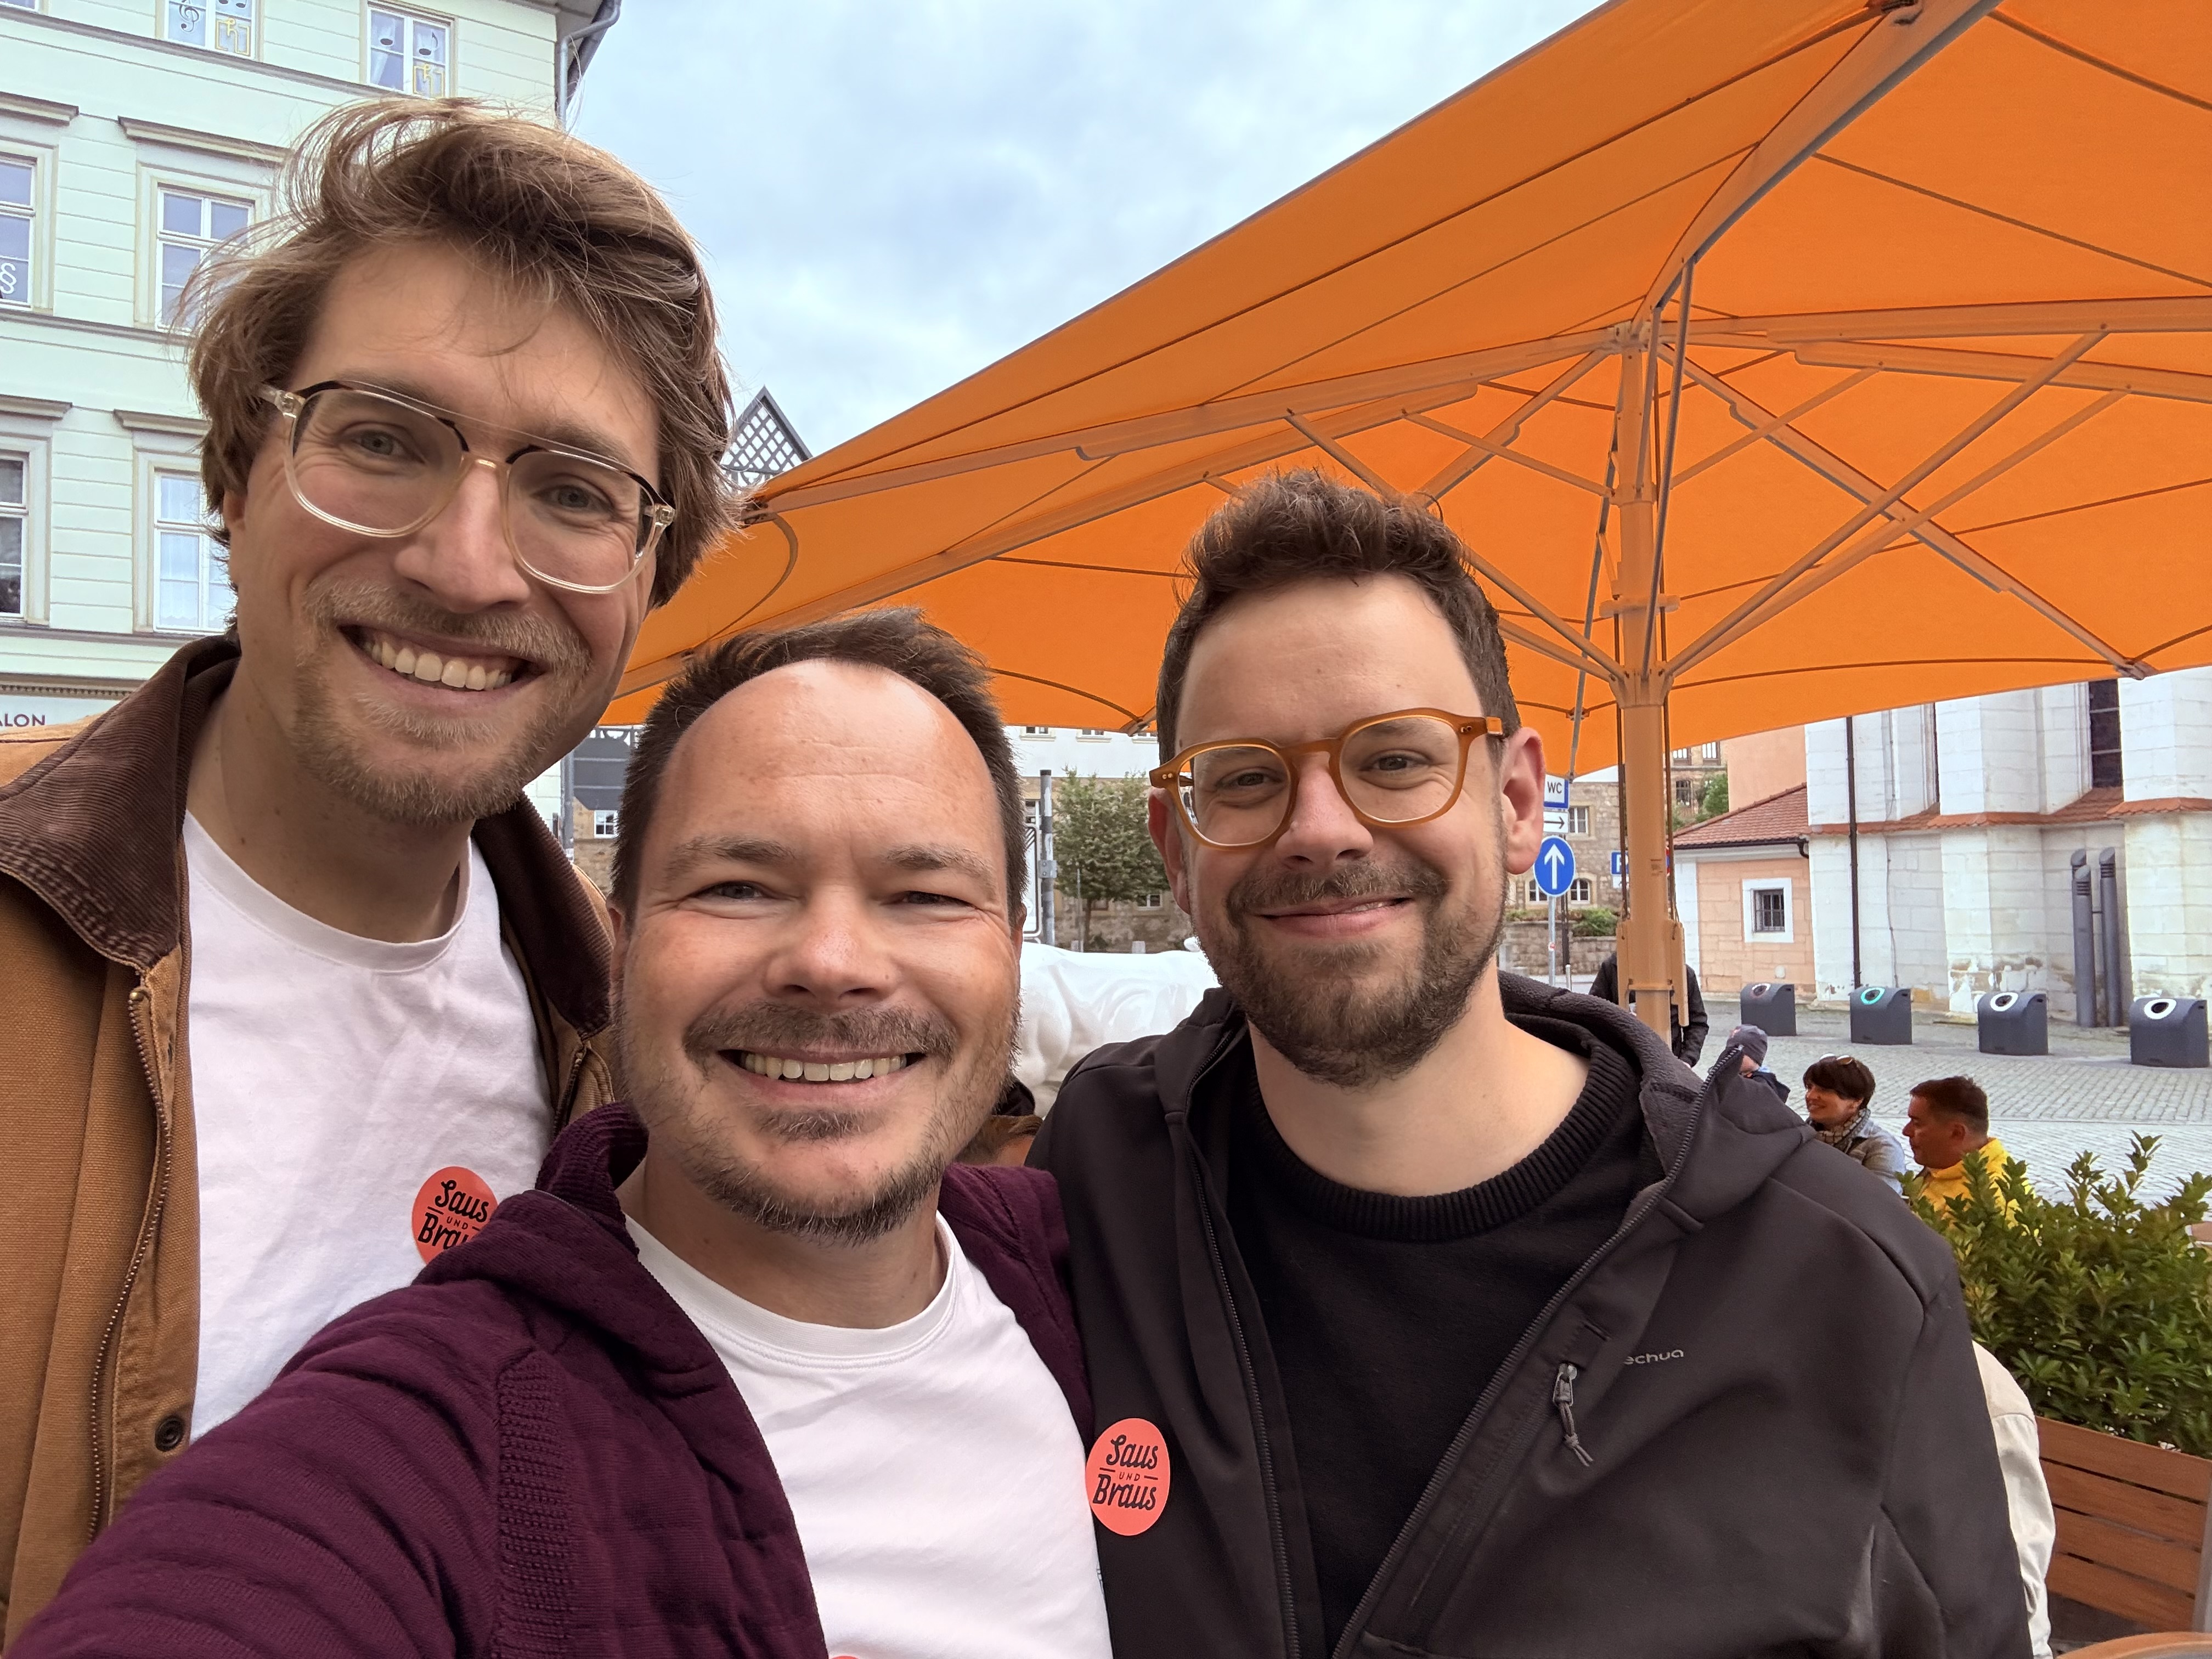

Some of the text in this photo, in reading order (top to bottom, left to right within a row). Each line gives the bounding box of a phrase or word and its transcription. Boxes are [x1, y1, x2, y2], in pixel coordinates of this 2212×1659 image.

[0, 713, 46, 727] LON
[1547, 781, 1562, 794] WC
[435, 1180, 489, 1222] Saus
[417, 1212, 469, 1250] Bra
[446, 1216, 469, 1229] UND
[1106, 1434, 1158, 1470] Saus
[1119, 1471, 1140, 1481] UND
[1092, 1474, 1156, 1511] Braus
